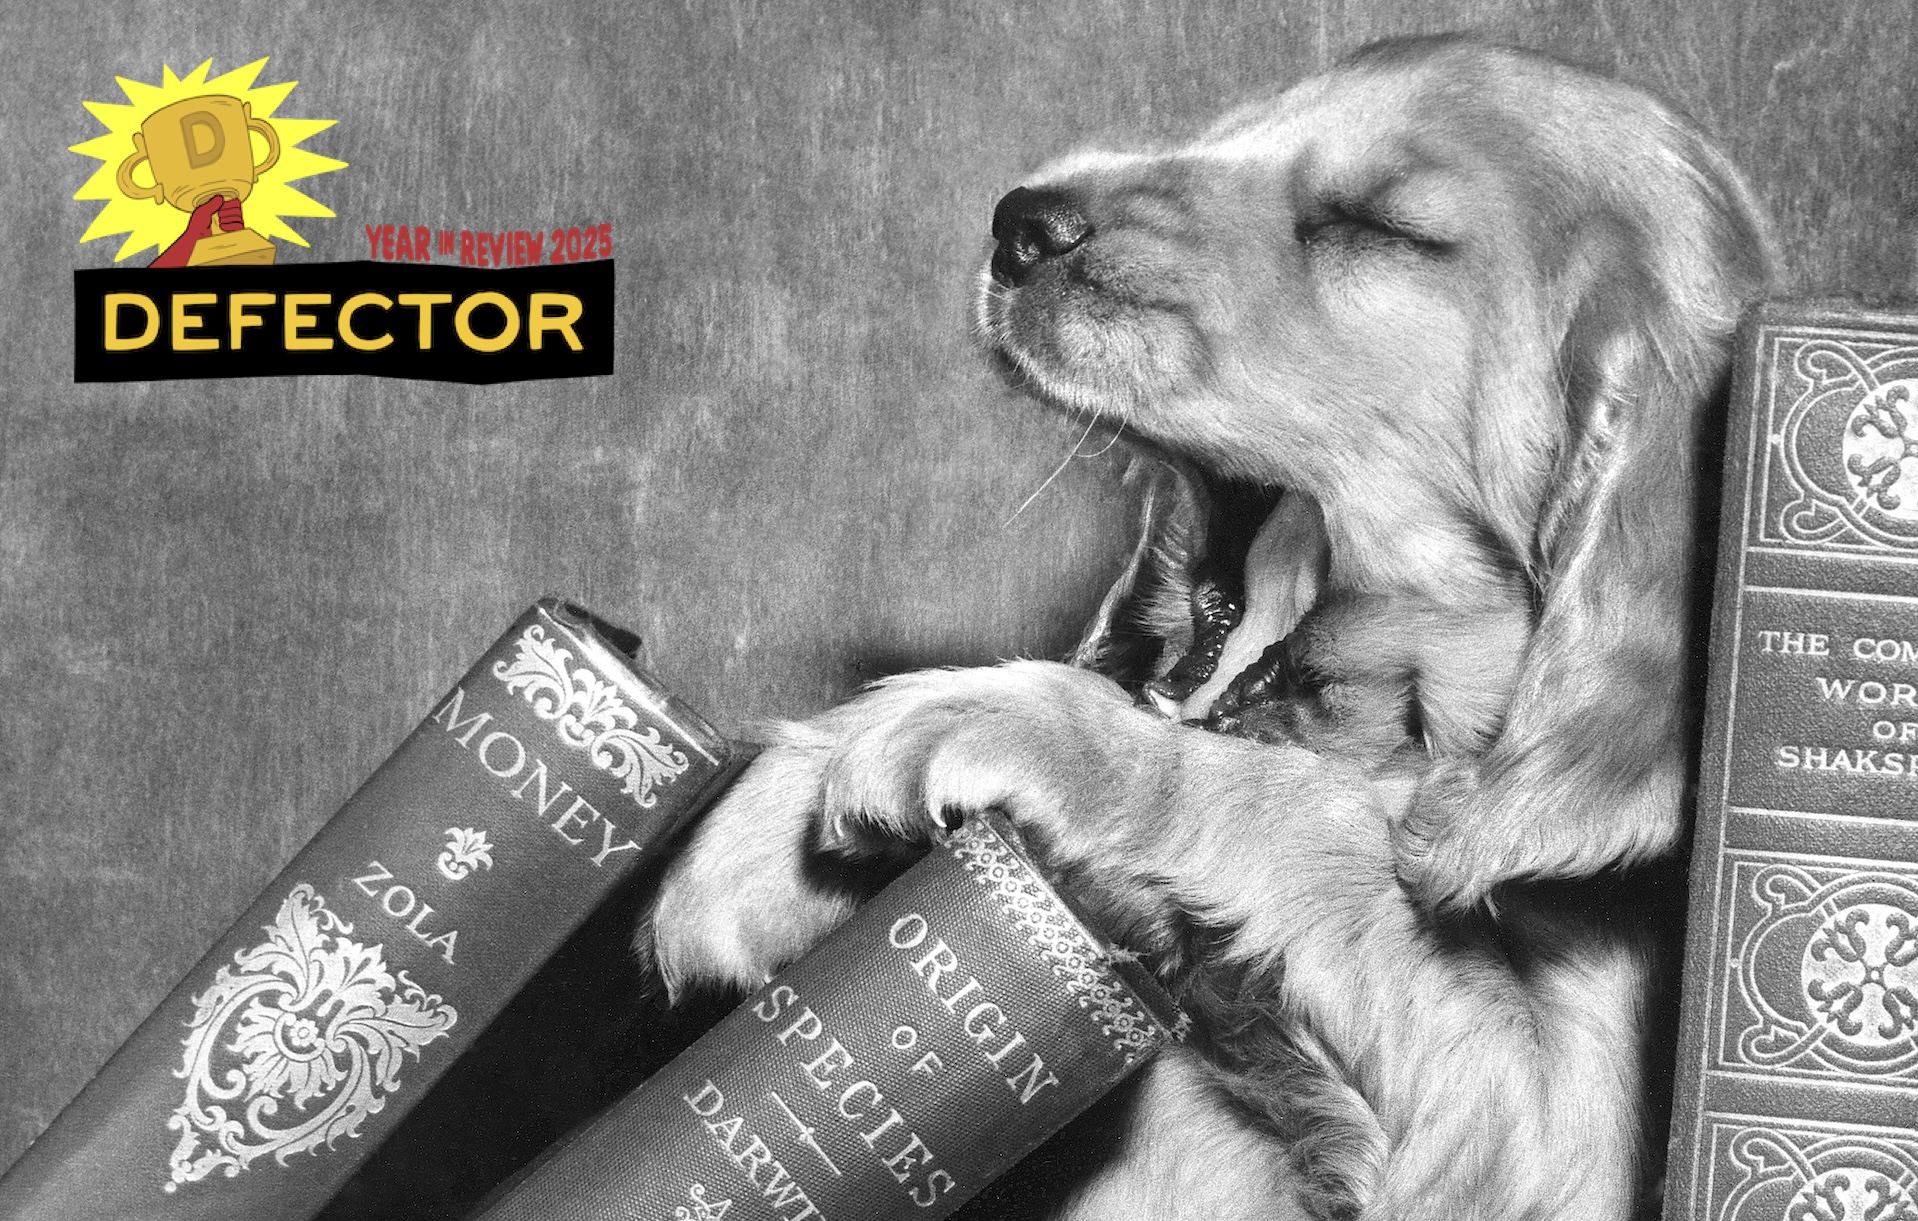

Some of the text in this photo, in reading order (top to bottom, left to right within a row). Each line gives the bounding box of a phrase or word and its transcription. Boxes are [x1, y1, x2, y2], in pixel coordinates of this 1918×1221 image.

[1758, 631, 1830, 656] THE
[1816, 677, 1918, 706] WOR
[433, 686, 642, 867] MONEY
[1872, 720, 1918, 742] OF
[353, 860, 459, 964] ZOLA
[889, 913, 1060, 1104] ORIGIN
[891, 1026, 943, 1078] OF
[752, 985, 955, 1207] SPECIES
[683, 1080, 826, 1221] DARWI
